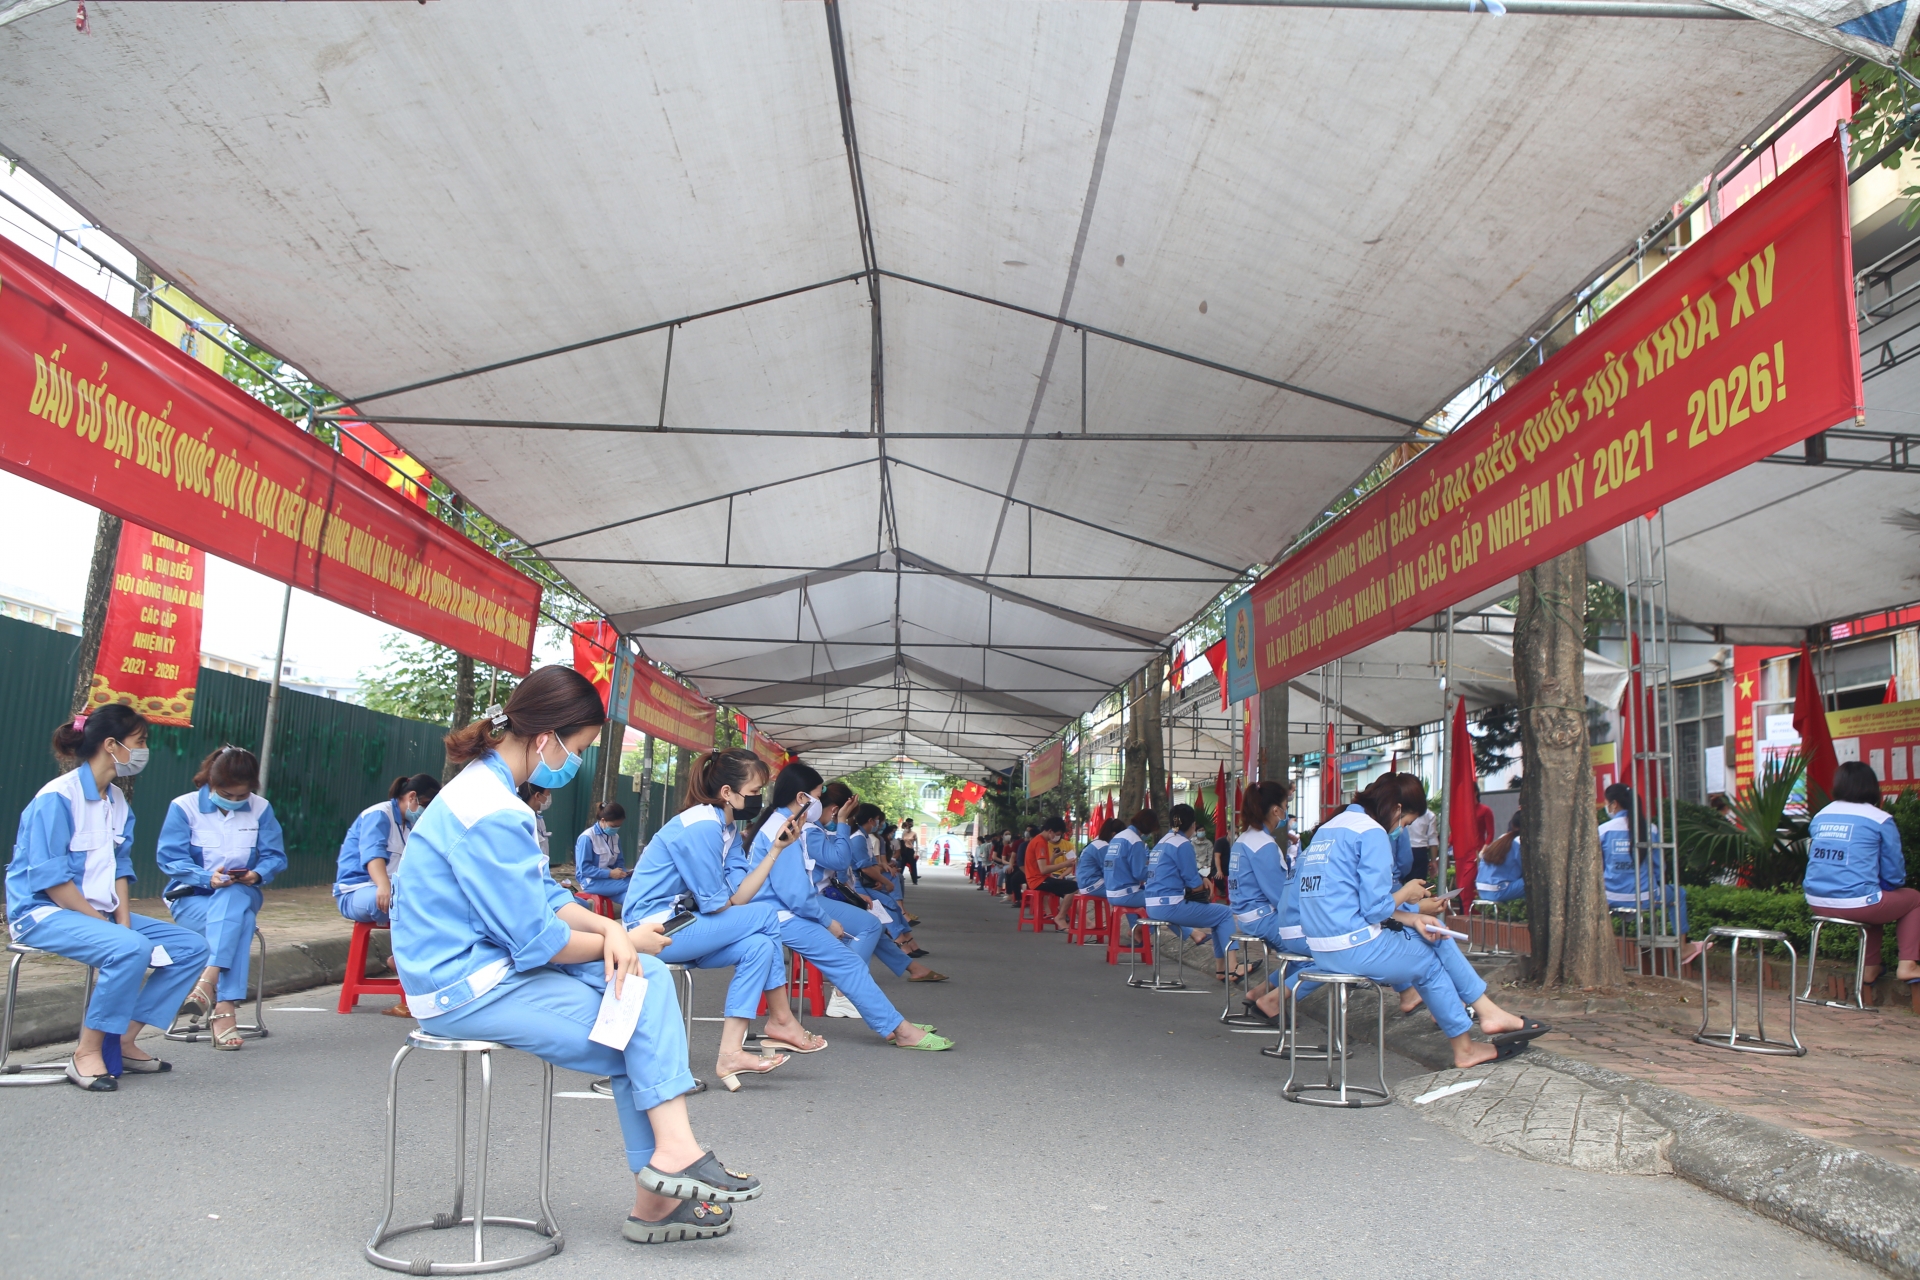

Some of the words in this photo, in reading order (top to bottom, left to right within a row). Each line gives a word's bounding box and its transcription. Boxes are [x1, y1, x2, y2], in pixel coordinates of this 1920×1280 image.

[1264, 590, 1285, 627] NHIỆT
[1285, 576, 1300, 615] LIỆT
[1302, 562, 1325, 603] CHÀO
[1326, 541, 1356, 588] MỪNG
[1358, 518, 1388, 568] NGÀY
[1390, 492, 1416, 547] BẦU
[1419, 468, 1441, 527] CỬ
[1442, 461, 1472, 513] ĐẠI
[1473, 421, 1516, 493] BIỂU
[1518, 381, 1580, 463] QUỐC
[1582, 350, 1629, 421] HỘI
[1632, 290, 1720, 388] KHÓA
[1727, 241, 1776, 328] XV
[76, 361, 108, 443] CỬ
[103, 393, 136, 469] ĐẠI
[136, 400, 176, 478] BIỂU
[174, 427, 215, 498] QUỐC
[214, 449, 241, 519] HỘI
[238, 461, 258, 519] VÀ
[256, 476, 280, 537] ĐẠI
[277, 477, 307, 542] BIỂU
[302, 497, 325, 559] HỘI
[322, 502, 350, 564] ĐỒNG
[347, 524, 375, 575] NHÂN
[372, 534, 392, 584] DÂN
[390, 544, 407, 591] CÁC
[1265, 637, 1276, 669] VÀ
[1276, 635, 1289, 667] ĐẠI
[1290, 613, 1308, 657] BIỂU
[1310, 609, 1324, 650] HỘI
[1326, 595, 1354, 639] ĐỒNG
[1354, 577, 1387, 625] NHÂN
[1388, 560, 1416, 607] DÂN
[1417, 541, 1447, 591] CÁC
[1450, 512, 1483, 574] CẤP
[1487, 480, 1551, 555] NHIỆM
[1556, 452, 1585, 518] KỲ
[1592, 419, 1654, 500] 2021
[1666, 428, 1678, 444] -
[1687, 339, 1787, 449] 2026!
[142, 552, 153, 572] VÀ
[156, 557, 170, 578] ĐẠI
[170, 558, 193, 581] BIỂU
[115, 573, 134, 596] HỘI
[136, 575, 161, 599] ĐỒNG
[162, 585, 187, 606] NHÂN
[140, 605, 159, 625] CÁC
[161, 607, 177, 629] CẤP
[132, 631, 164, 653] NHIỆM
[164, 636, 176, 654] KỲ
[120, 656, 146, 675] 2021
[154, 662, 180, 680] 2026!
[1819, 824, 1848, 832] NITORI
[1813, 847, 1844, 860] 26179
